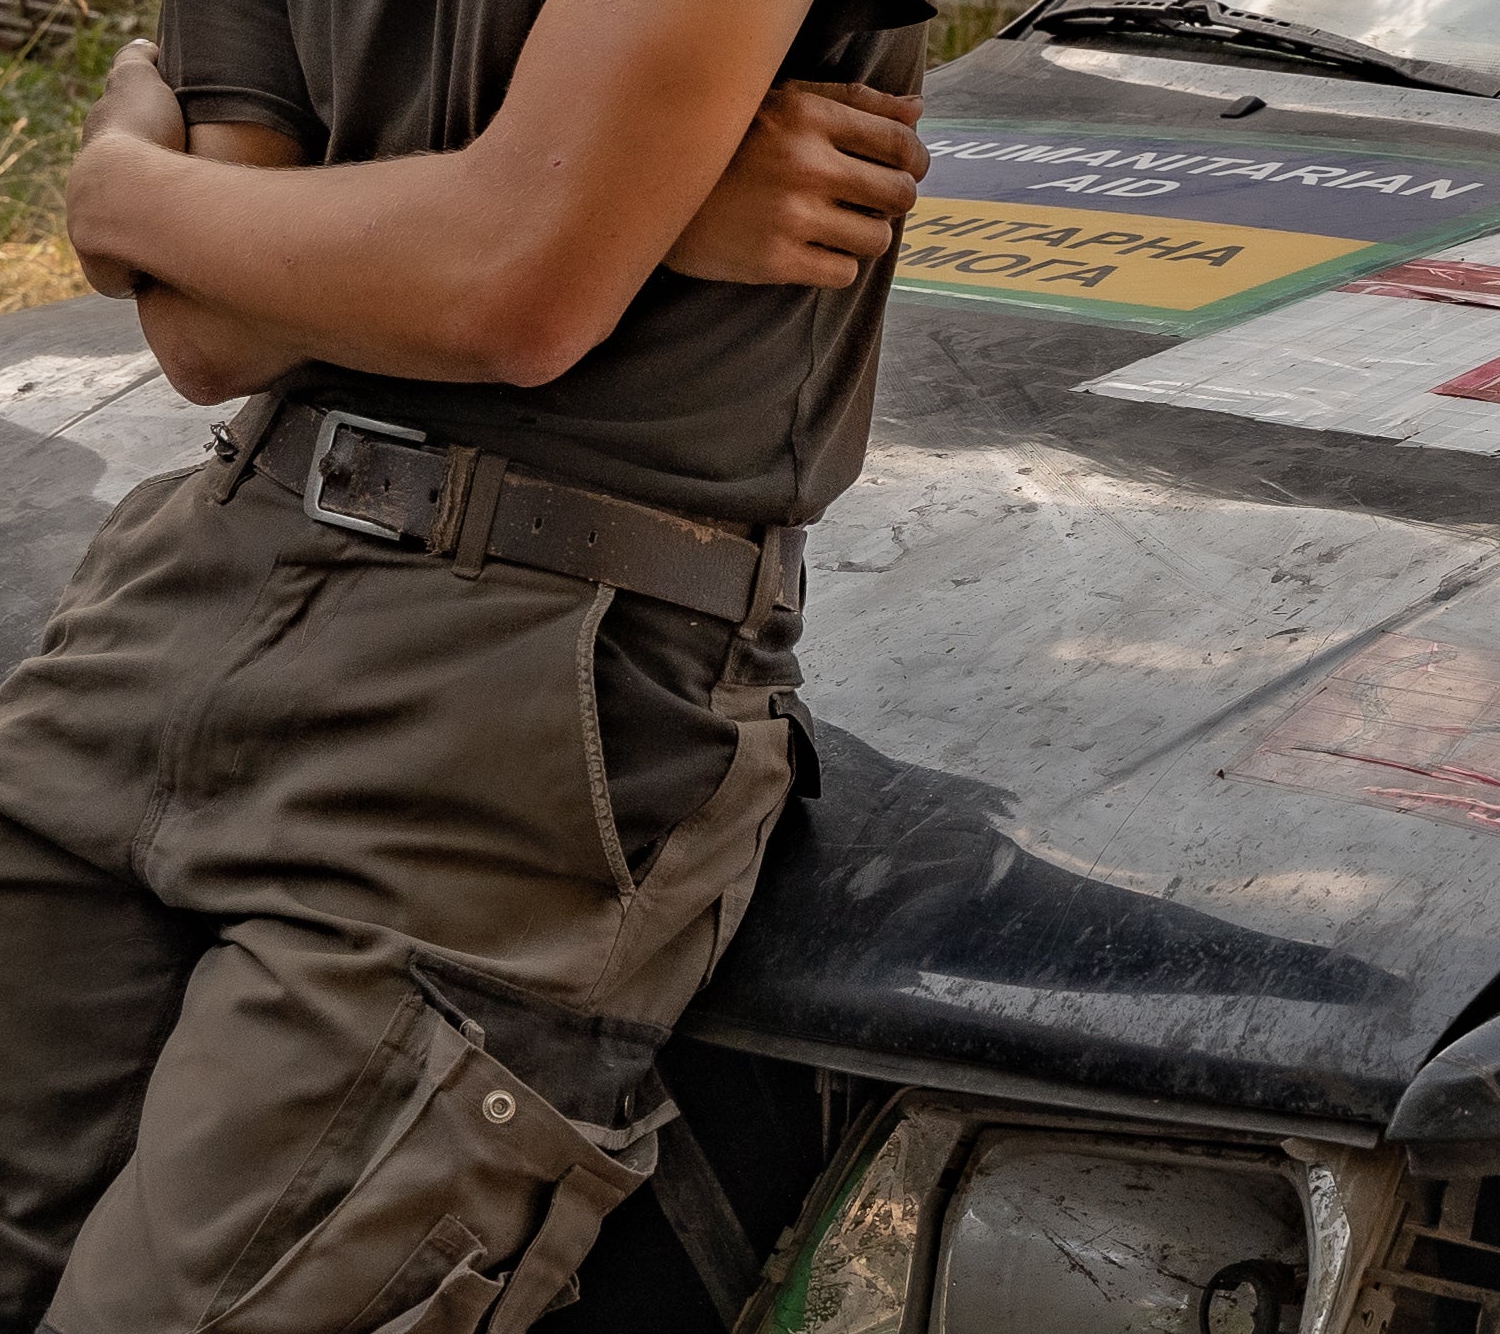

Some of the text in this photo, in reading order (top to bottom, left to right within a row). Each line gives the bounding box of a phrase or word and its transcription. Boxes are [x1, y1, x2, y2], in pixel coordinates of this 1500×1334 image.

[926, 140, 1483, 201] HUMANITARIAN
[1027, 174, 1182, 198] AID
[904, 213, 1246, 268] НІТАРНА
